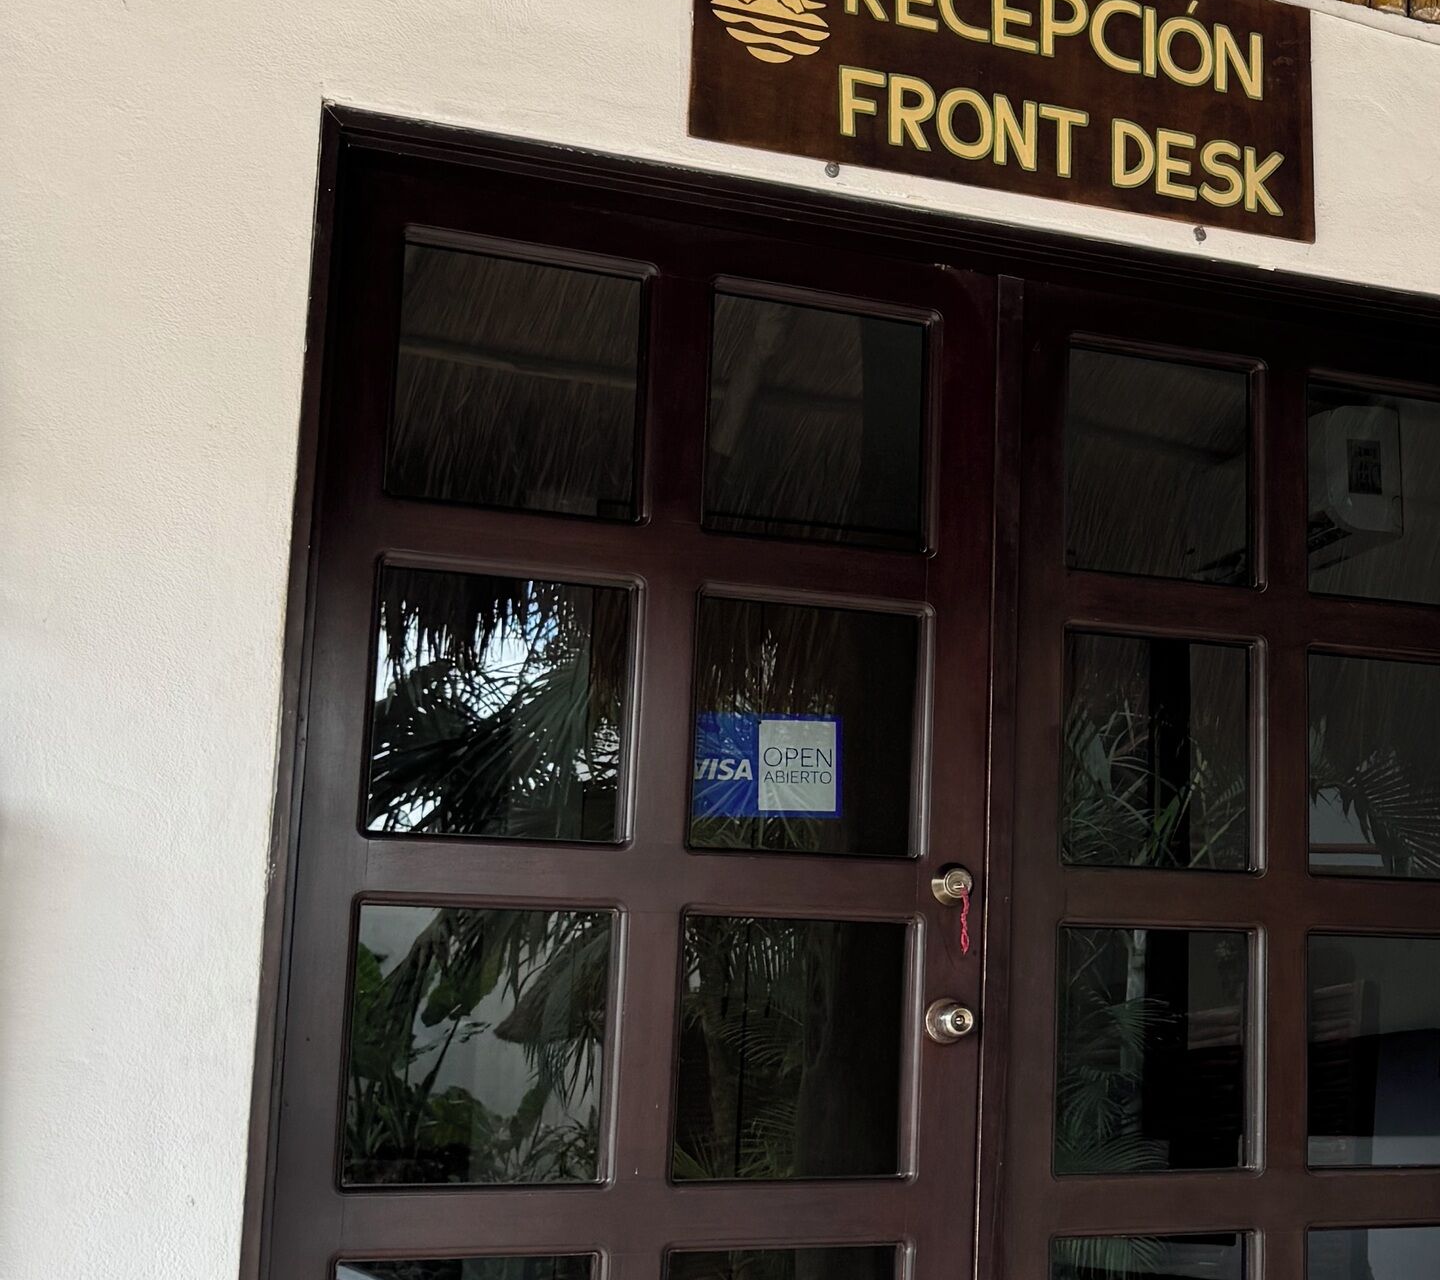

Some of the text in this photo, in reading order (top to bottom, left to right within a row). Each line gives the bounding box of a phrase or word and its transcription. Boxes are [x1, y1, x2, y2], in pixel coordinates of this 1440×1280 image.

[838, 64, 1285, 218] FRONT DESK
[763, 747, 832, 767] OPEN
[763, 771, 832, 784] ABIERTO
